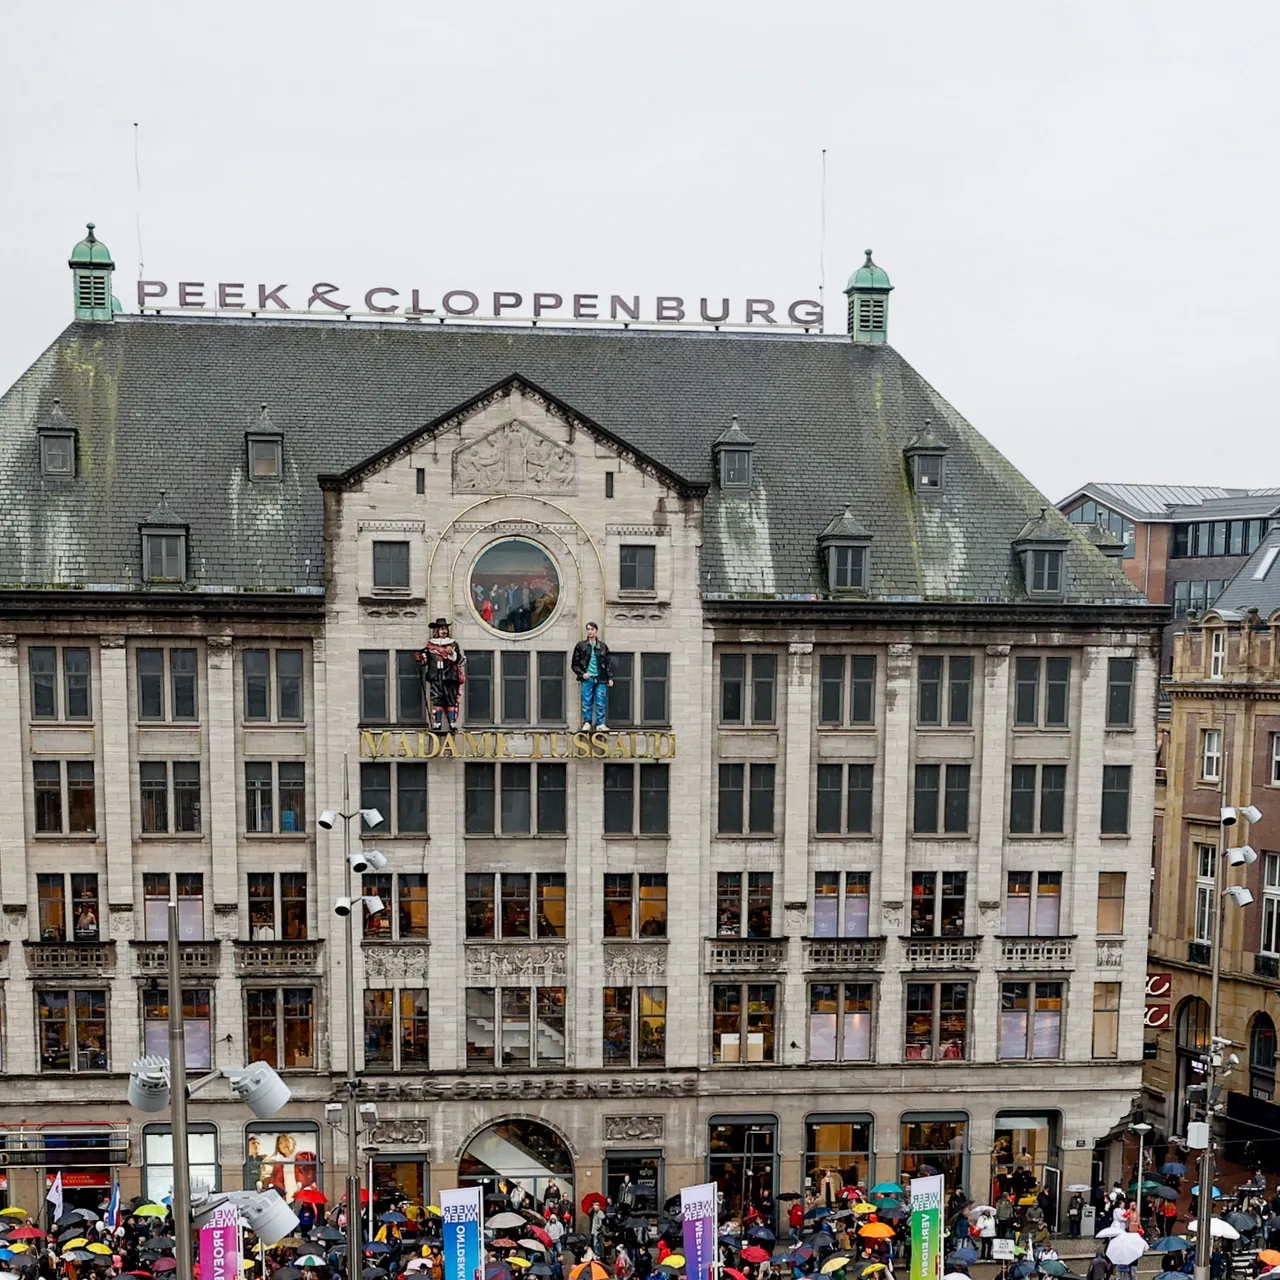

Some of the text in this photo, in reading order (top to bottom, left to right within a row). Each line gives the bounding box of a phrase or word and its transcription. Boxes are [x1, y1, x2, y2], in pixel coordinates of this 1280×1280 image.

[136, 281, 825, 325] PEEK & CLOPPENBURG
[359, 731, 677, 760] MADAME TUSSAUD
